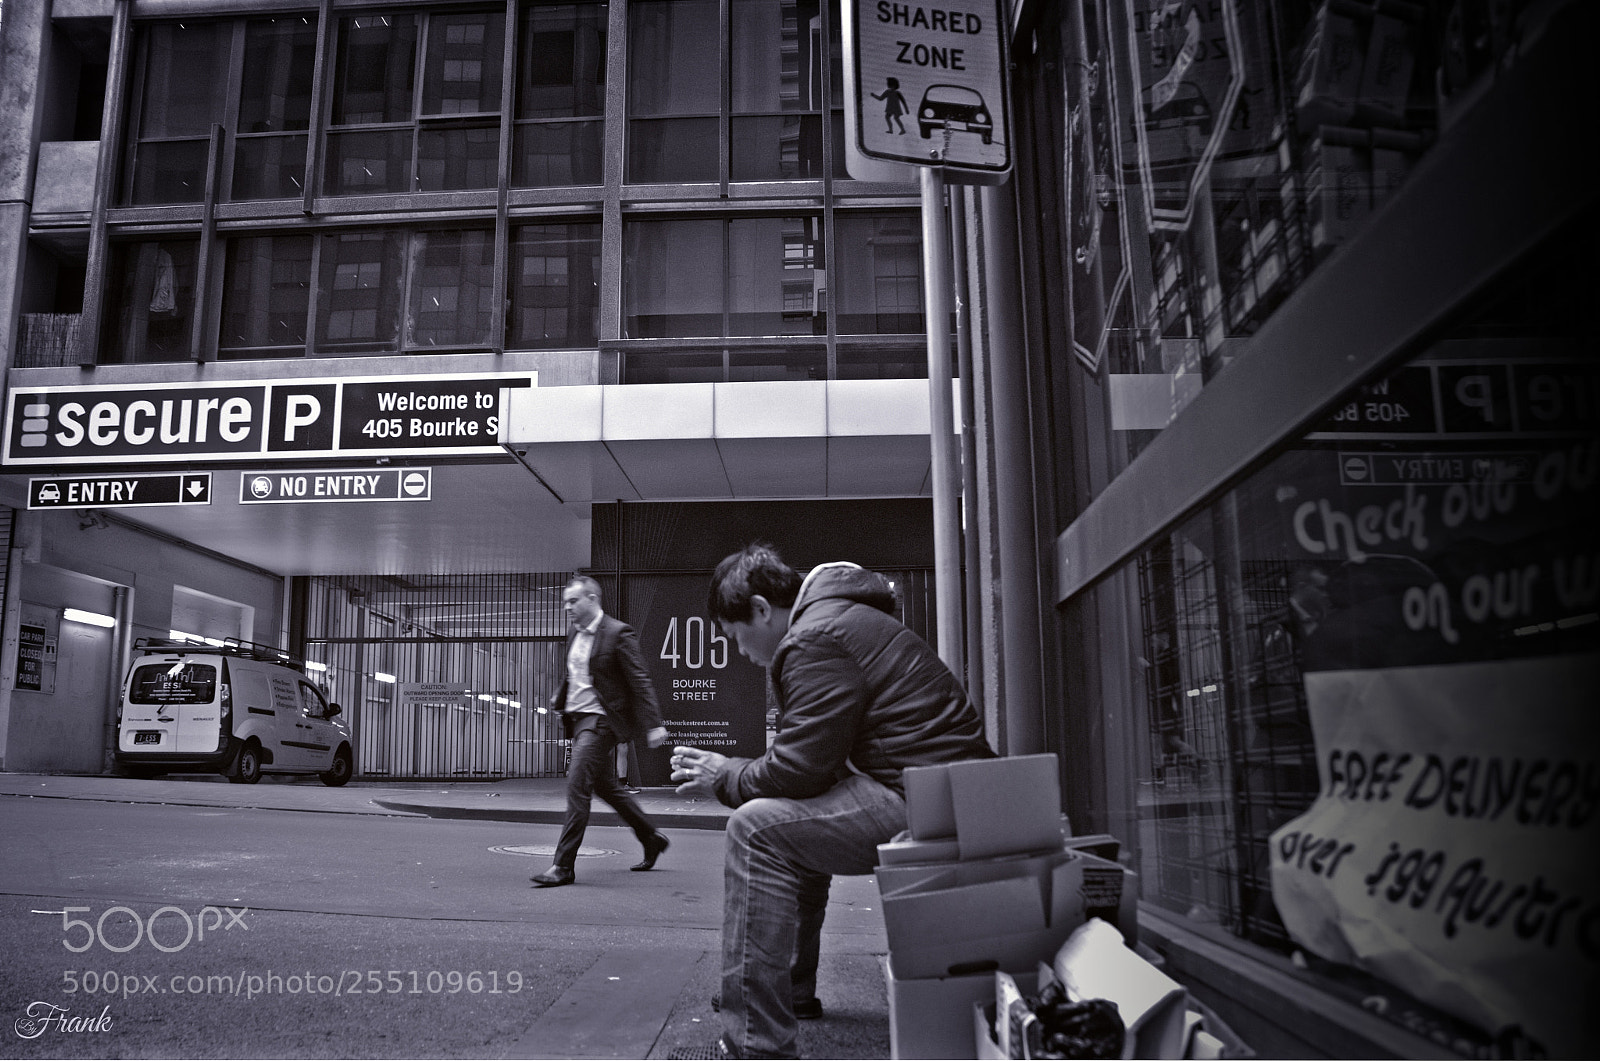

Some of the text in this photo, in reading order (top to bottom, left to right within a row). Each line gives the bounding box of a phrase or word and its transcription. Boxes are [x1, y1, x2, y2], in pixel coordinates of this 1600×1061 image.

[877, 1, 982, 35] SHARED
[896, 41, 966, 70] ZONE
[377, 392, 494, 412] Welcome to
[55, 396, 252, 447] secure
[284, 394, 321, 442] P
[362, 416, 499, 438] 405 Bourke S
[67, 482, 138, 503] ENTRY
[280, 476, 380, 497] NO ENTRY
[660, 617, 728, 669] 405
[20, 648, 41, 660] CLOSED
[24, 661, 36, 672] FOR
[672, 680, 716, 688] BOURKE
[672, 692, 716, 701] STREET
[678, 731, 698, 739] leasing
[700, 731, 727, 739] enquiries
